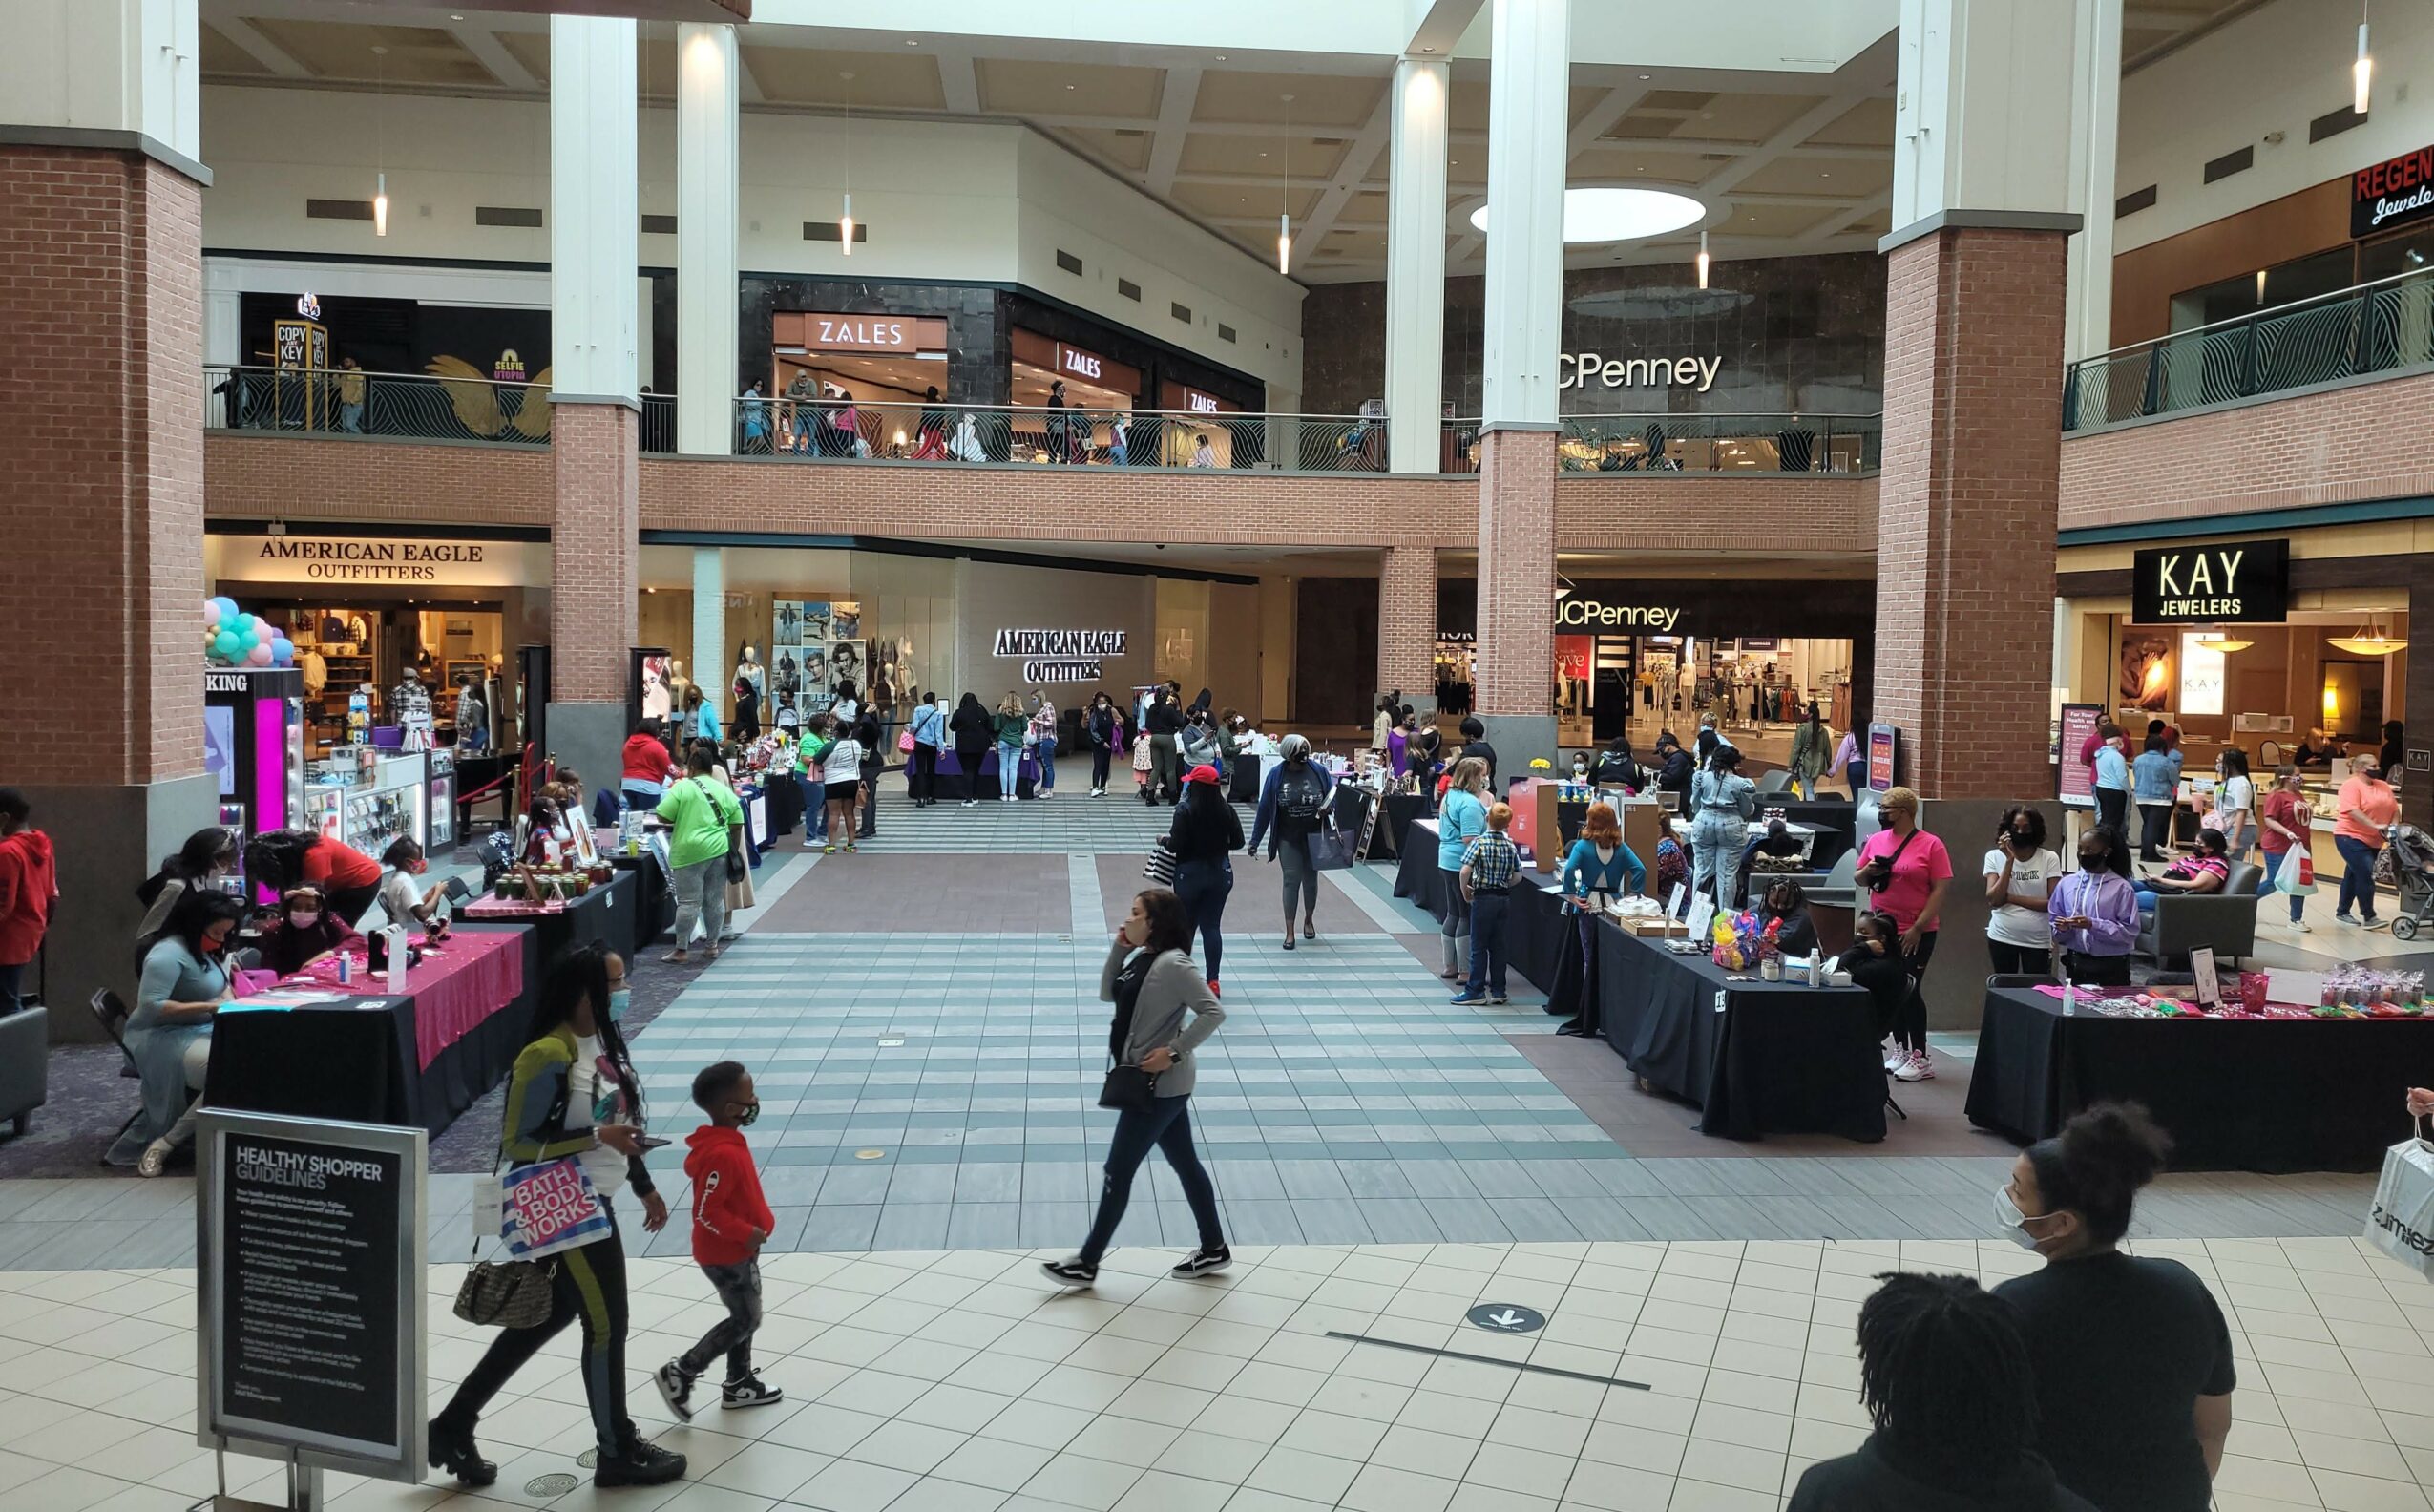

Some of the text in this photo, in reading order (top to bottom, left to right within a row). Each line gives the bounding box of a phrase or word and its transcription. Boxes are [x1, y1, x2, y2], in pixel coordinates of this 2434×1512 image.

[2357, 147, 2434, 202] REGEN
[2372, 184, 2434, 225] Jewele
[278, 326, 306, 342] COPY
[312, 330, 325, 346] COPY
[819, 322, 902, 345] ZALES
[281, 345, 303, 361] KEY
[313, 348, 324, 366] KEY
[1065, 350, 1101, 378] ZALES
[493, 370, 525, 380] UTOPIA
[494, 361, 524, 370] SELFIE
[1559, 353, 1721, 392] CPenney
[1191, 393, 1217, 412] ZALES
[260, 541, 483, 562] AMERICAN EAGLE
[307, 563, 435, 580] OUTFITTERS
[2159, 550, 2243, 597] KAY
[1555, 600, 1680, 632] JCPenney
[2159, 598, 2242, 616] JEWELERS
[995, 630, 1127, 656] AMERICAN EAGLE
[1025, 661, 1102, 682] OUTFITTERS
[205, 674, 248, 692] KING
[2184, 679, 2219, 688] KAY
[236, 1146, 382, 1182] HEALTHY SHOPPER
[236, 1163, 326, 1190] GUIDELINES
[515, 1166, 572, 1206] BATH
[514, 1181, 587, 1228] & BODY
[519, 1195, 599, 1246] WORKS
